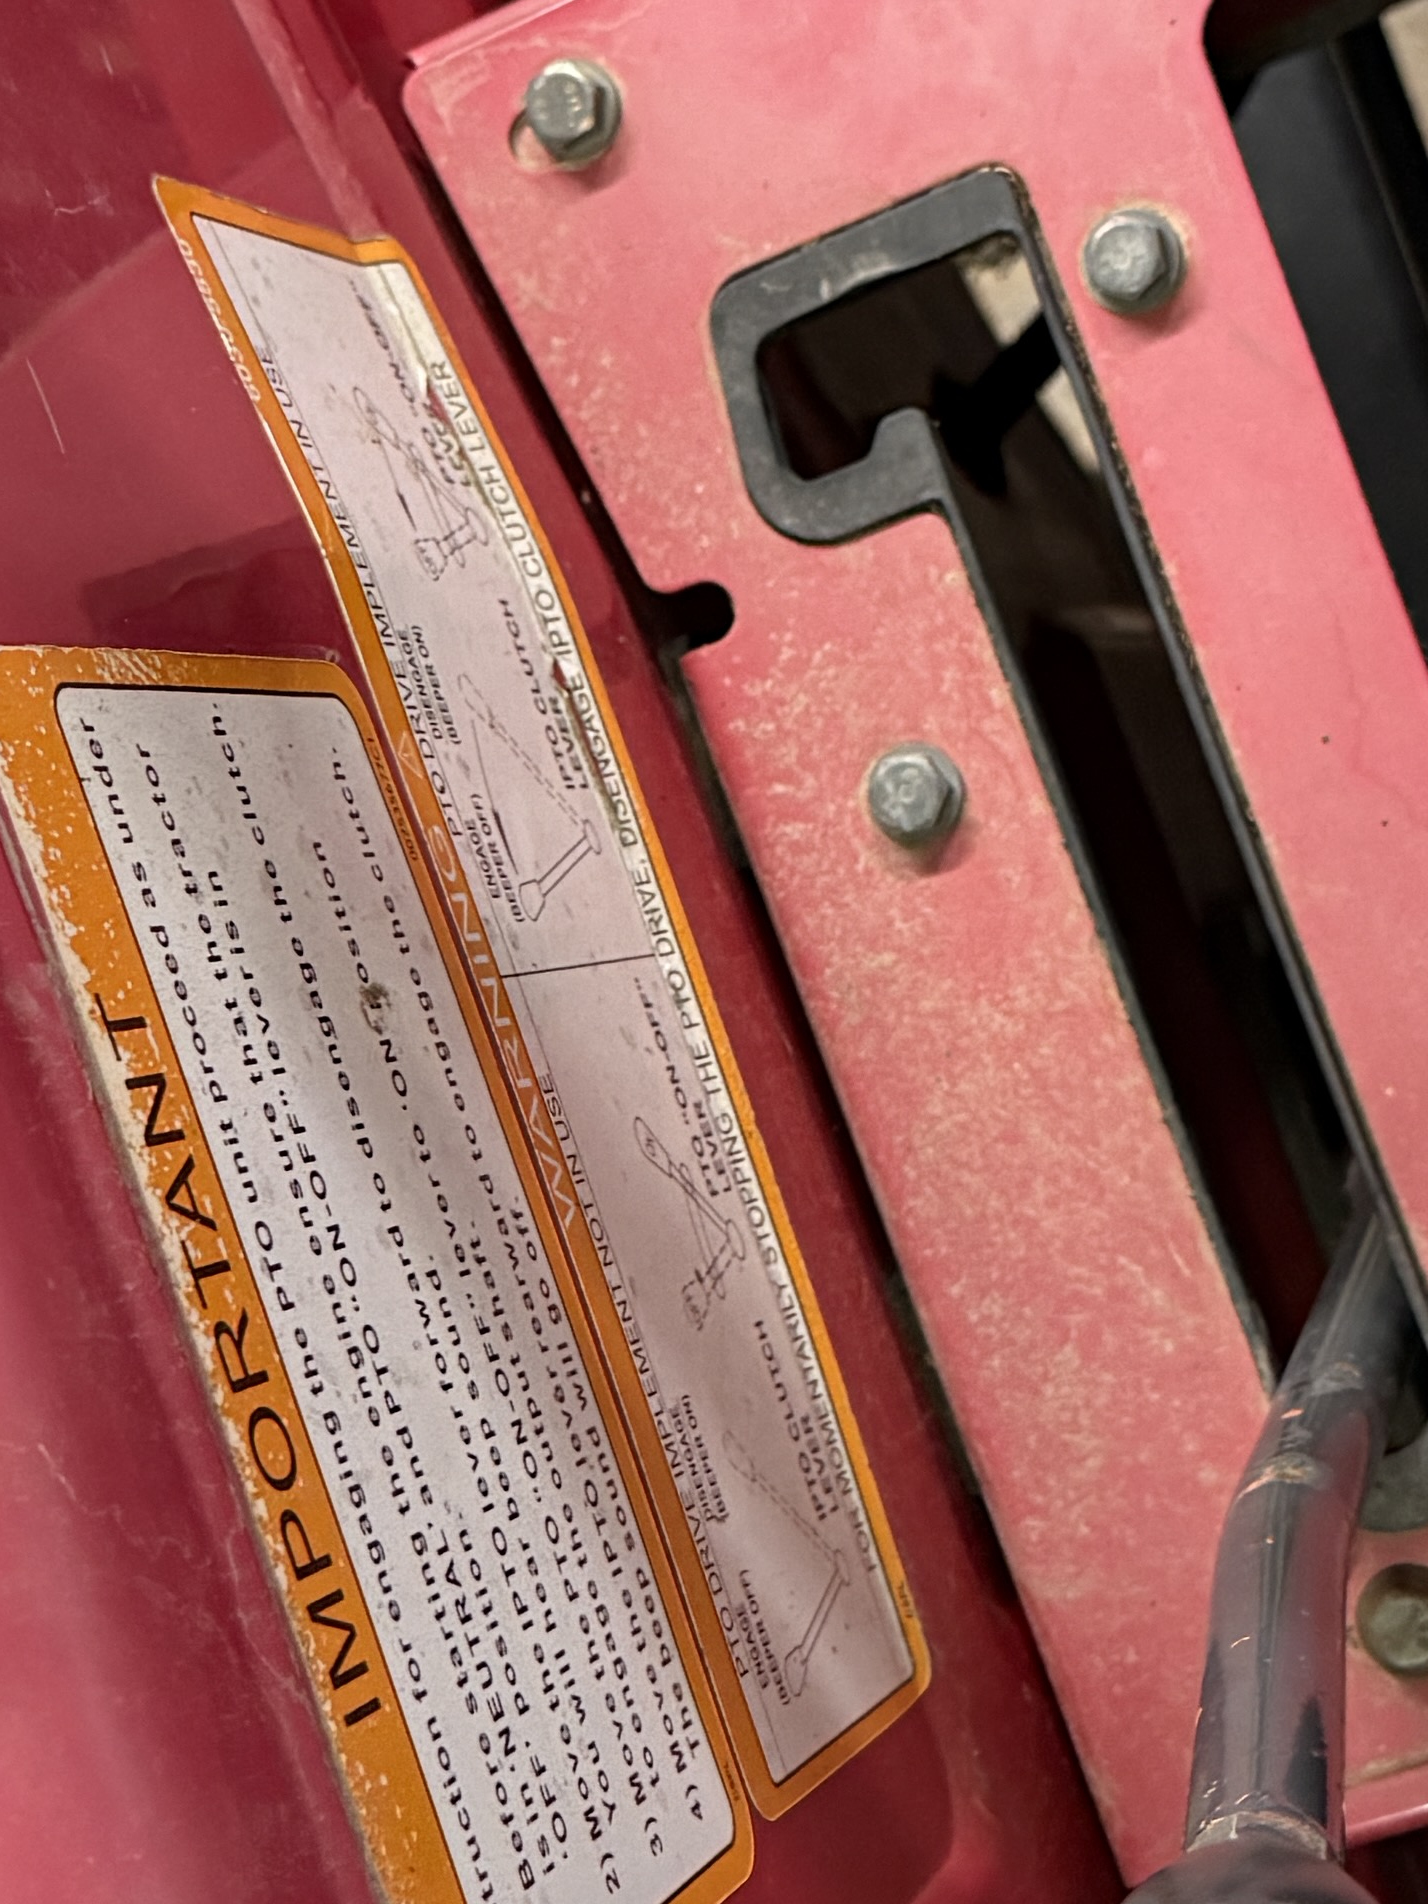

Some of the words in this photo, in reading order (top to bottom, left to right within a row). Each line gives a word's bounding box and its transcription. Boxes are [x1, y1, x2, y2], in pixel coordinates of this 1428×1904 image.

[262, 356, 292, 407] USE
[431, 362, 485, 451] LEVER
[286, 418, 312, 448] IN
[422, 428, 455, 484] PTO
[312, 466, 395, 646] IMPLEMENT
[479, 465, 542, 577] CLUTCH
[412, 626, 429, 657] ON)
[499, 600, 547, 715] CLUTCH
[534, 589, 572, 657] IPTO
[395, 666, 434, 758] DRIVE
[399, 633, 443, 739] DISENGAGE
[425, 665, 461, 744] (BEEPER
[80, 718, 133, 843] under
[213, 704, 264, 845] clutch.
[546, 725, 575, 789] IPTO
[549, 698, 588, 789] LEVER
[137, 744, 198, 895] tractor
[333, 748, 383, 882] clutch.
[432, 771, 462, 836] PTO
[471, 794, 491, 836] OFF)
[133, 862, 156, 907] as
[208, 871, 228, 906] in
[265, 860, 292, 922] the
[466, 822, 500, 898] ENGAGE
[488, 843, 525, 922] (BEEPER
[198, 914, 228, 980] the
[226, 921, 244, 954] is
[384, 896, 409, 954] the
[150, 926, 228, 1102] proceed
[225, 998, 263, 1084] that
[240, 967, 286, 1075] lever
[410, 968, 464, 1111] engage
[423, 824, 579, 1229] WARNING
[667, 970, 700, 1029] PTO
[292, 937, 373, 1158] disengage
[689, 1043, 721, 1099] THE
[414, 1124, 431, 1162] to
[465, 1125, 482, 1161] to
[543, 1075, 569, 1141] USE
[694, 1102, 731, 1192] LEVER
[220, 1121, 257, 1203] unit
[264, 1103, 321, 1255] ensure
[373, 1173, 391, 1211] to
[567, 1155, 585, 1184] IN
[692, 1136, 719, 1197] PTO
[712, 1113, 777, 1268] STOPPING
[255, 1221, 295, 1311] PTO
[430, 1178, 471, 1277] lever
[479, 1175, 549, 1353] rearward
[511, 1199, 537, 1261] off.
[582, 1202, 613, 1267] NOT
[387, 1226, 453, 1391] forward
[470, 1222, 513, 1341] shaft.
[540, 1278, 561, 1324] go
[94, 993, 381, 1727] IMPORTANT
[295, 1328, 323, 1395] the
[323, 1275, 380, 1426] engine
[363, 1325, 401, 1414] PTO
[425, 1256, 479, 1400] sound.
[547, 1367, 587, 1467] lever
[557, 1342, 587, 1411] will
[612, 1285, 684, 1478] IMPLEMENT
[755, 1321, 799, 1441] CLUTCH
[771, 1282, 852, 1498] MOMENTARILY
[451, 1408, 494, 1513] lever
[510, 1355, 561, 1489] output
[801, 1416, 839, 1512] LEVER
[382, 1446, 410, 1515] the
[396, 1427, 433, 1504] and
[481, 1418, 519, 1521] beep
[586, 1427, 634, 1551] sound
[672, 1413, 716, 1521] DISENGAGE
[799, 1452, 826, 1521] IPTO
[323, 1411, 400, 1621] engaging
[545, 1516, 579, 1602] PTO
[563, 1504, 587, 1568] the
[584, 1480, 622, 1577] IPTO
[681, 1493, 723, 1595] DRIVE
[848, 1509, 876, 1573] FOR
[459, 1514, 529, 1716] position.
[492, 1527, 533, 1630] IPTO
[519, 1539, 556, 1632] hear
[622, 1590, 646, 1652] the
[636, 1568, 671, 1667] beep
[411, 1532, 478, 1714] starting
[580, 1615, 604, 1680] the
[588, 1581, 641, 1733] engage
[720, 1607, 749, 1677] PTO
[737, 1611, 768, 1689] ENGAGE
[400, 1639, 427, 1702] for
[534, 1644, 559, 1711] the
[555, 1650, 585, 1724] will
[605, 1694, 646, 1805] Move
[647, 1665, 686, 1773] Move
[673, 1683, 699, 1758] The
[521, 1783, 538, 1824] in
[560, 1725, 602, 1841] Move
[588, 1741, 616, 1824] You
[643, 1747, 659, 1787] to
[686, 1785, 702, 1820] 4)
[479, 1734, 535, 1890] Before
[538, 1835, 554, 1874] is
[645, 1817, 662, 1856] 3)
[601, 1853, 620, 1893] 2)
